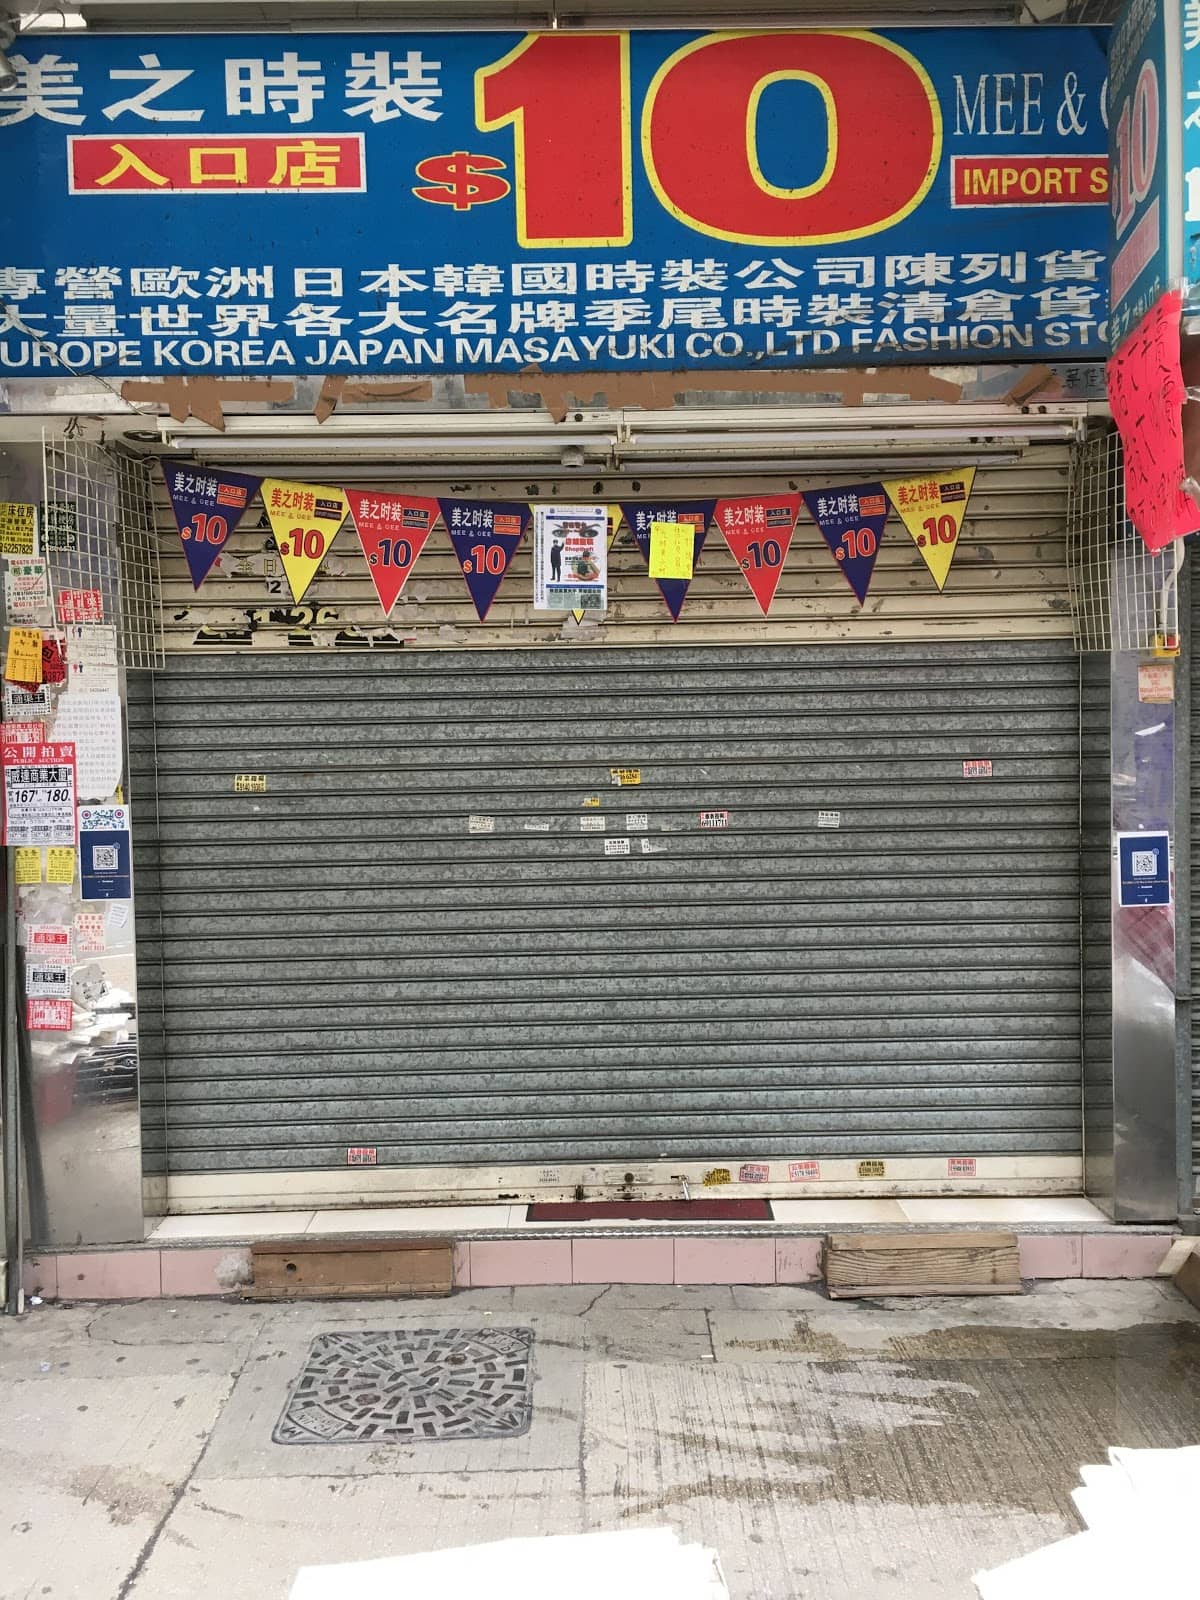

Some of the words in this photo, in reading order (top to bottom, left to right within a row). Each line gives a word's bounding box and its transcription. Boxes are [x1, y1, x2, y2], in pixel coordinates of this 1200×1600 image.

[0, 52, 443, 126] 美之時裝
[953, 73, 1045, 136] MEE
[1056, 71, 1088, 136] &
[95, 143, 341, 187] 入口店
[963, 167, 1082, 195] IMPORT
[154, 339, 296, 366] KOREA
[305, 337, 444, 366] JAPAN
[456, 333, 675, 365] MASAYUKI
[851, 322, 1033, 353] FASHION
[174, 472, 218, 497] 美之时装
[898, 480, 939, 505] 美之时装
[271, 488, 315, 511] 美之时装
[360, 499, 401, 521] 美之时装
[817, 493, 858, 517] 美之时装
[451, 507, 494, 529] 美之时装
[724, 504, 765, 527] 美之时装
[4, 745, 73, 758] 公開拍賣
